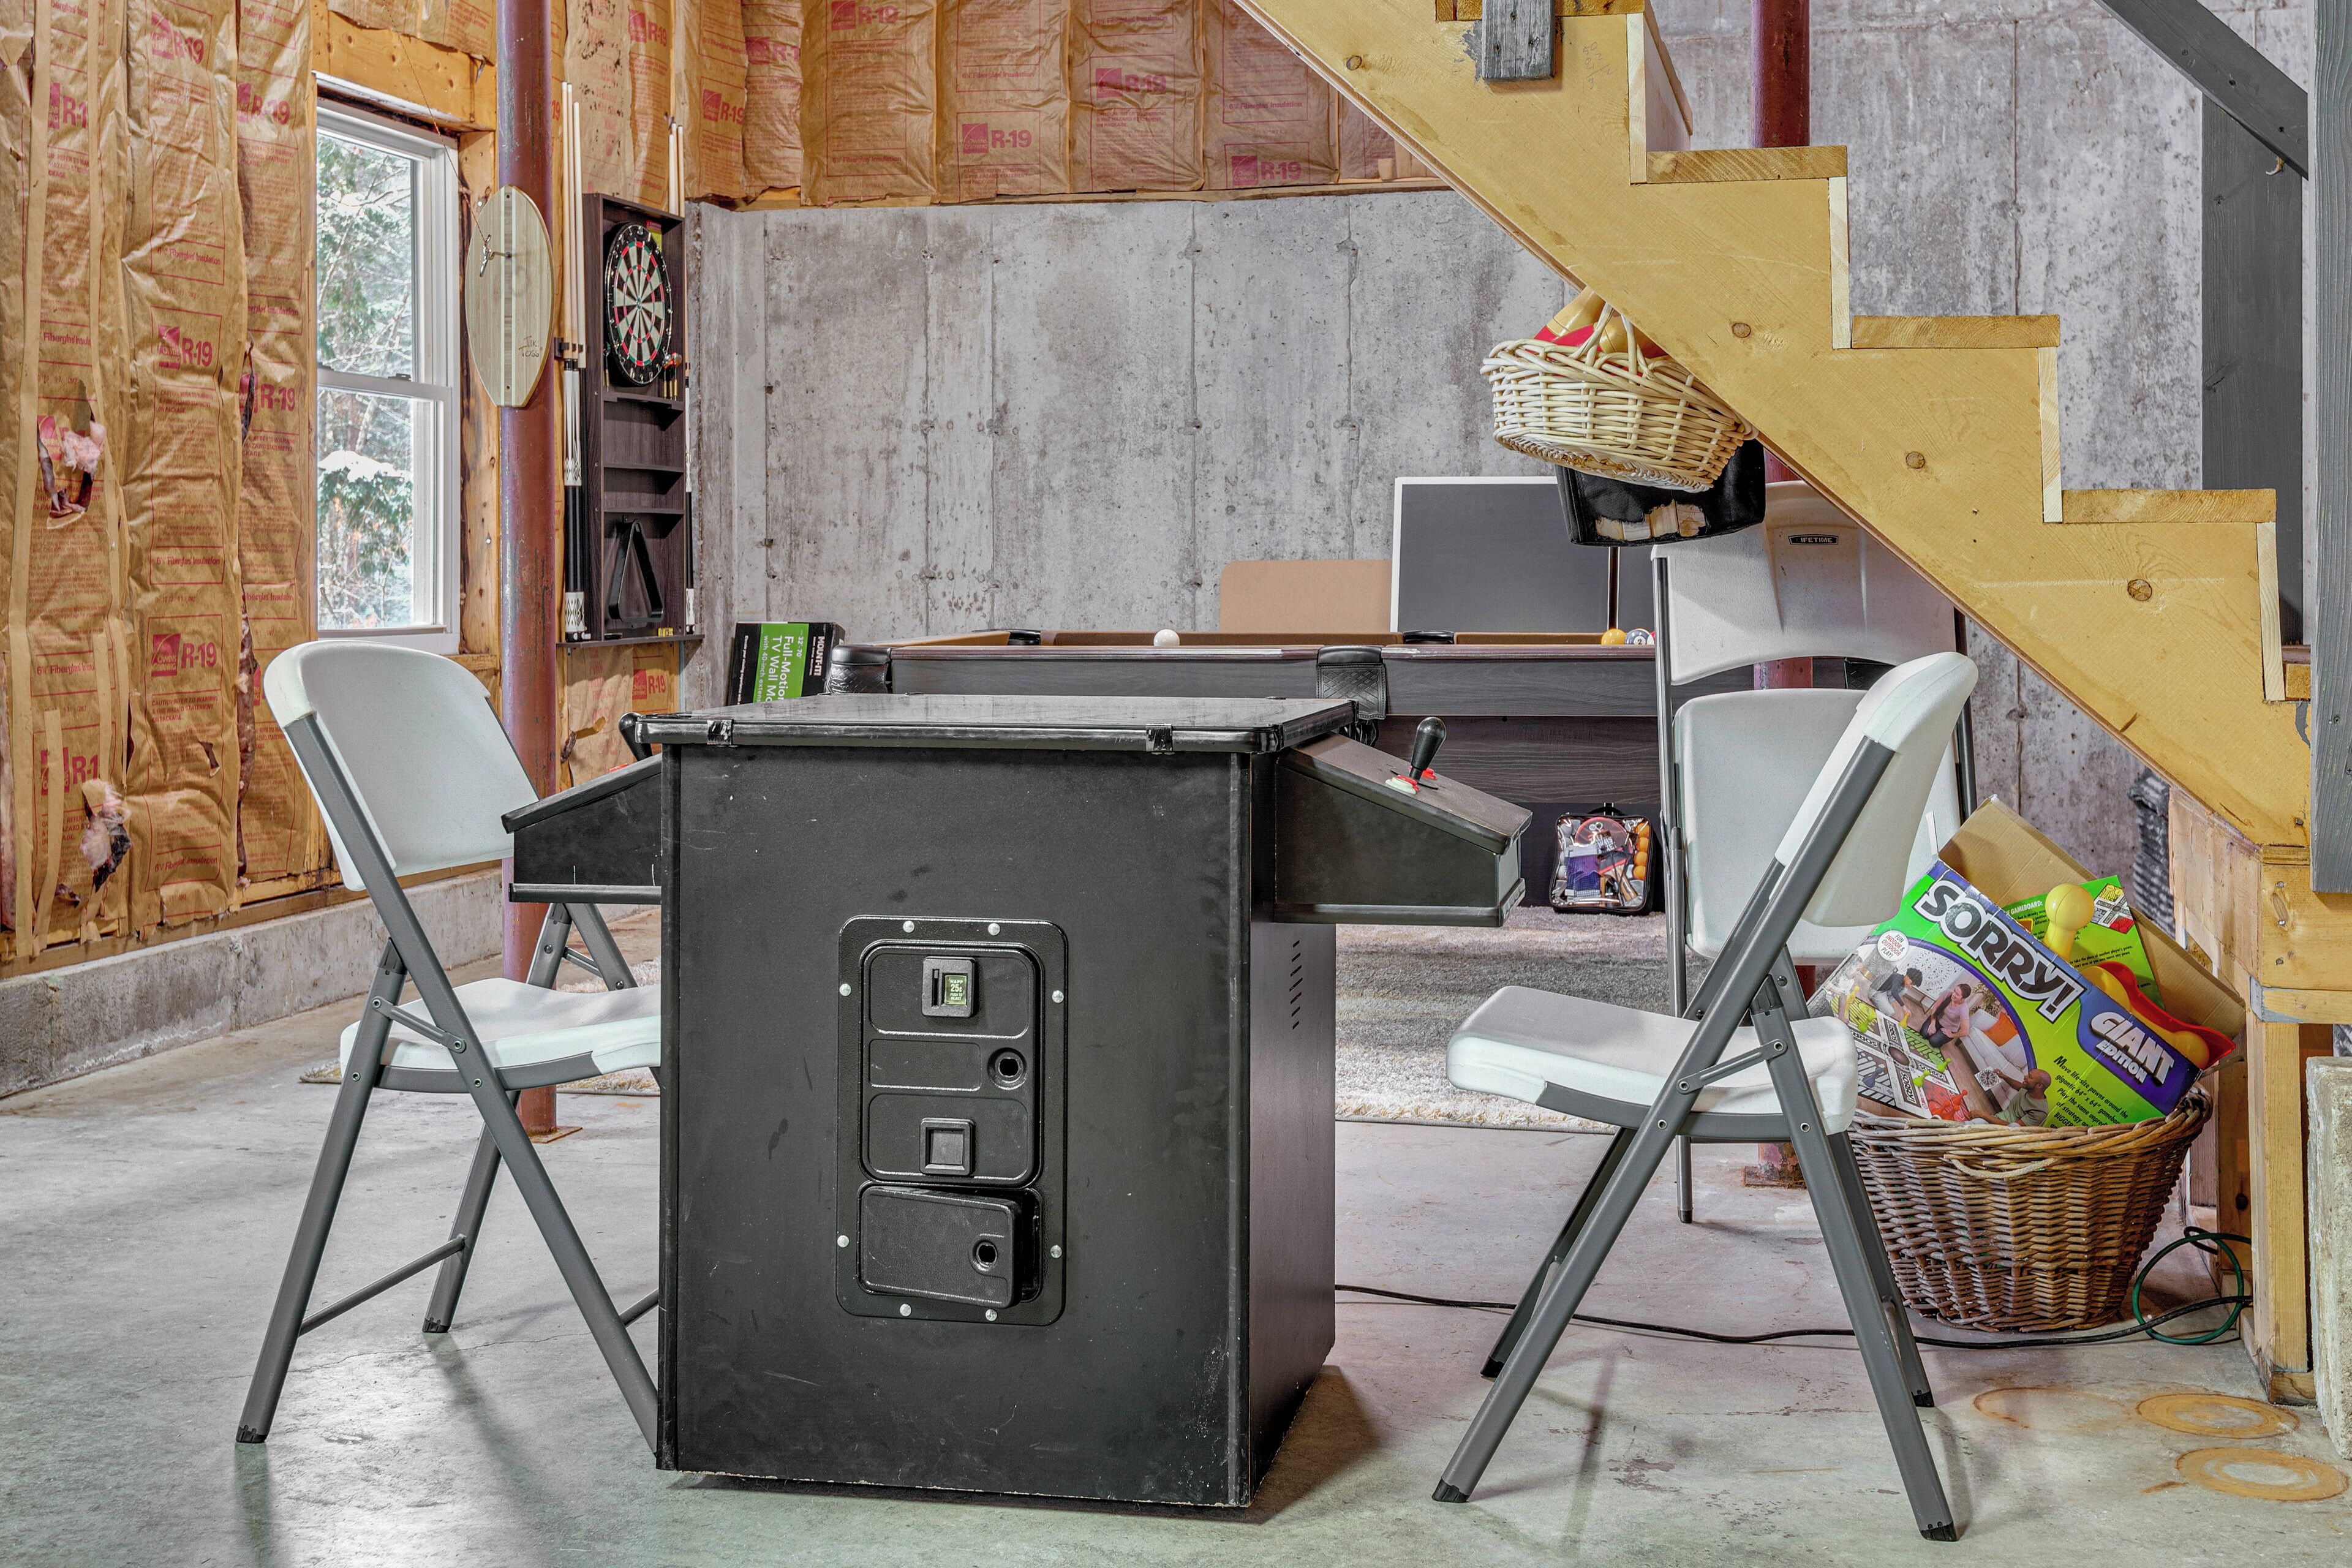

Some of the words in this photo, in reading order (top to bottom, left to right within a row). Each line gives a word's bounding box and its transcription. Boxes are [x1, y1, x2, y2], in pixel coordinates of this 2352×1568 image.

[858, 6, 899, 24] R-19
[773, 43, 799, 62] R-1
[1125, 74, 1167, 94] R-19
[63, 95, 87, 128] R-1
[552, 100, 560, 121] 19
[991, 129, 1032, 148] R-19
[1261, 160, 1302, 181] R-19
[182, 337, 212, 367] R-19
[261, 383, 295, 412] R-19
[772, 635, 783, 652] TV
[181, 642, 217, 668] R-19
[760, 651, 768, 677] 40-inch
[813, 635, 826, 677] MOUNT-IT!
[82, 662, 94, 671] Insu
[767, 655, 780, 681] Wall
[648, 675, 666, 694] R-19
[72, 754, 99, 785] R-1
[2010, 900, 2043, 915] GAMEBOARD:
[1882, 939, 1902, 957] OUTDOOR
[1886, 934, 1902, 949] INDOOR
[1894, 934, 1905, 943] FUN
[1881, 947, 1894, 959] PLAY!
[1915, 881, 2082, 1020] SORRY!
[1852, 1032, 1879, 1048] SORR
[2090, 1011, 2175, 1085] GIANT
[2095, 1039, 2148, 1084] EDITION
[2053, 1055, 2071, 1074] Move
[2070, 1071, 2090, 1088] life-size
[2087, 1087, 2105, 1101] pawns
[2104, 1098, 2122, 1113] around
[2120, 1108, 2128, 1119] the
[2054, 1074, 2076, 1091] gigantic
[2098, 1108, 2120, 1125] gamebo
[2057, 1088, 2069, 1099] Play
[2068, 1096, 2078, 1106] the
[2076, 1104, 2090, 1115] same
[2062, 1106, 2082, 1123] strategy
